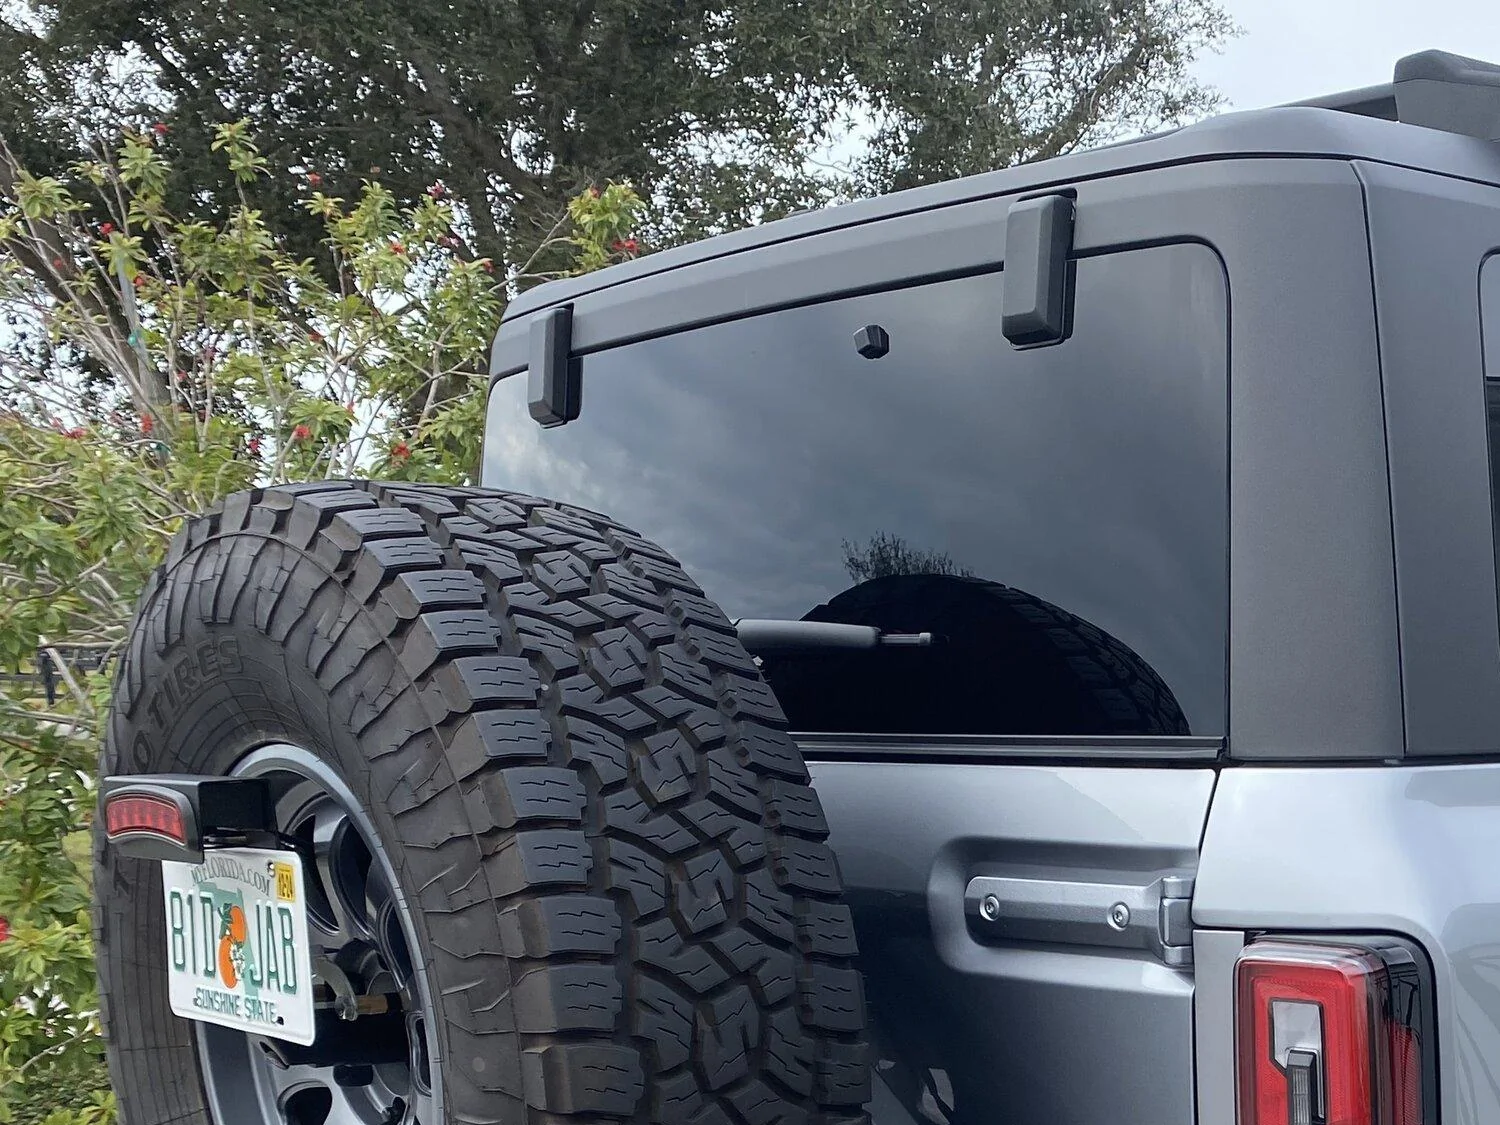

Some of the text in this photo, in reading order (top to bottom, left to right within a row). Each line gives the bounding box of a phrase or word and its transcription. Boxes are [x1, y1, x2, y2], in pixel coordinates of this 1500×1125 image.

[147, 635, 244, 732] TIRES
[250, 902, 297, 995] JAB
[194, 986, 279, 1026] SUNSHINE STATE
